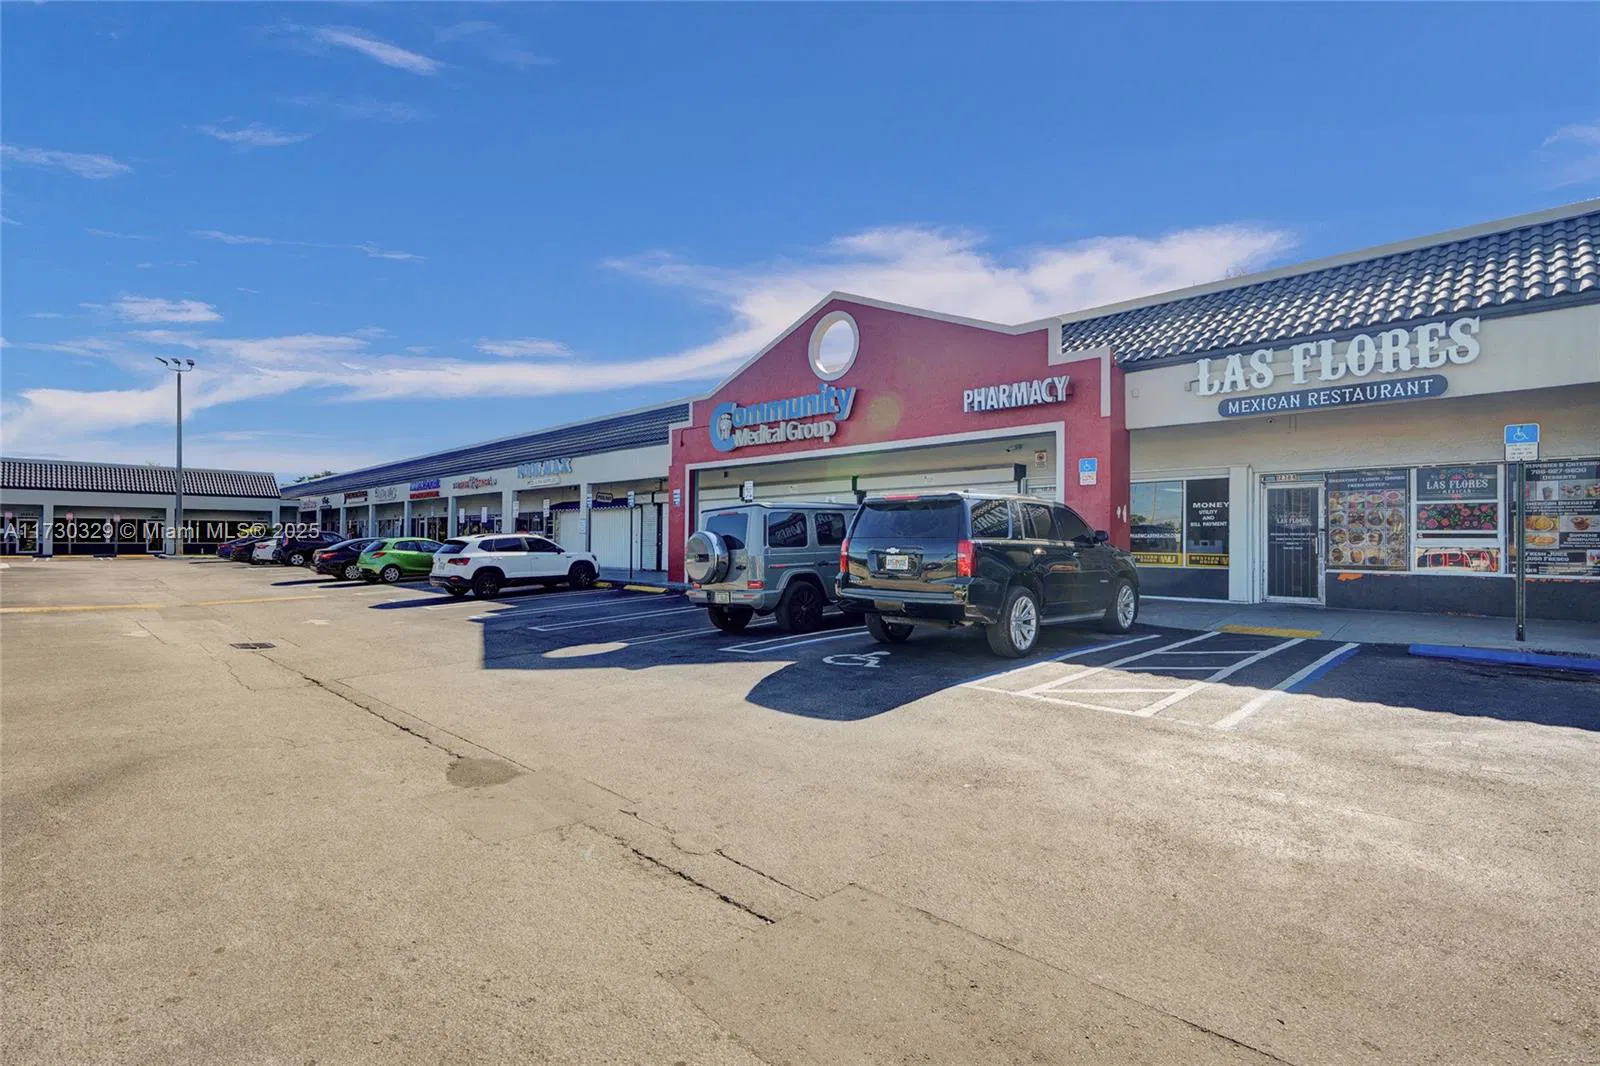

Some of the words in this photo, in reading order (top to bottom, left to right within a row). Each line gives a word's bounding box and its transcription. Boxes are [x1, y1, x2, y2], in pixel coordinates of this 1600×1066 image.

[1196, 348, 1275, 396] LAS
[1290, 316, 1480, 385] FLORES
[963, 375, 1071, 413] PHARMACY
[1228, 393, 1301, 415] MEXICAN
[1308, 379, 1435, 406] RESTAURANT
[709, 383, 857, 452] Community
[734, 423, 786, 447] Medical
[786, 420, 837, 443] Group
[1426, 480, 1446, 489] LAS
[1449, 479, 1489, 489] FLORES
[1192, 501, 1230, 509] MONEY
